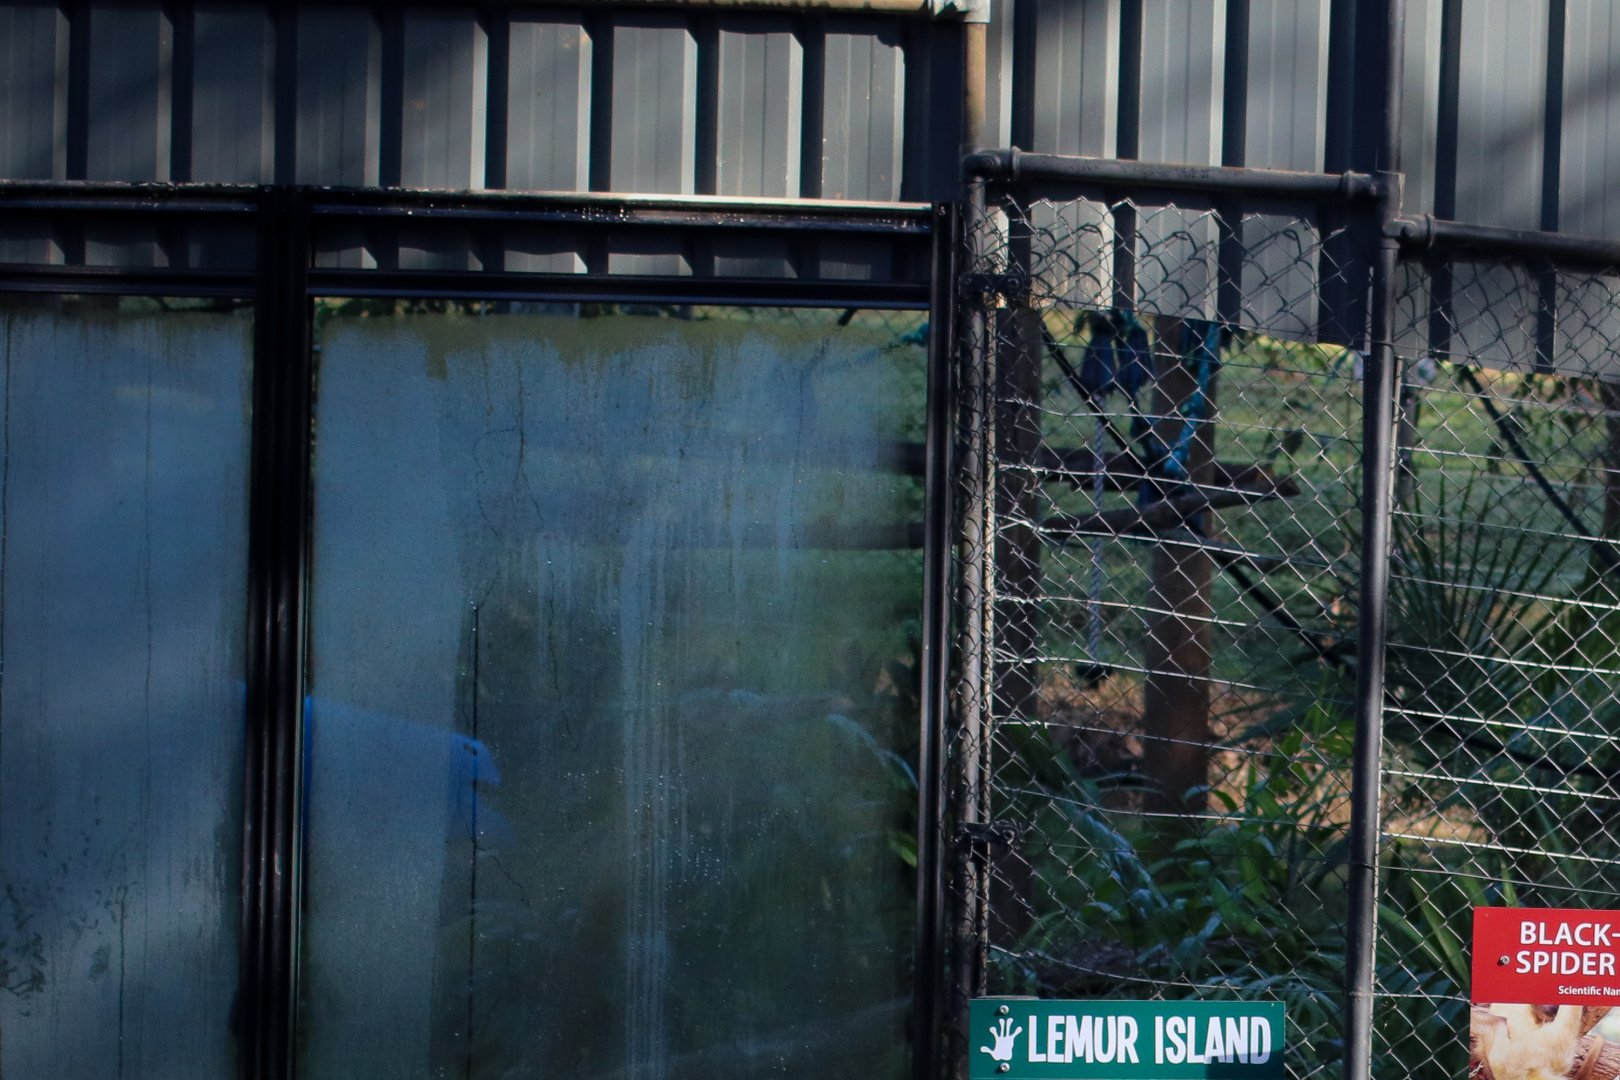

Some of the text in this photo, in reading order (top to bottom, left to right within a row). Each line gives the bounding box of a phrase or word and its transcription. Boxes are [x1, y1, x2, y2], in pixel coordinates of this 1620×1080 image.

[1515, 950, 1615, 976] SPIDER
[1558, 985, 1602, 996] Scientific
[1028, 1016, 1271, 1064] LEMUR ISLAND
